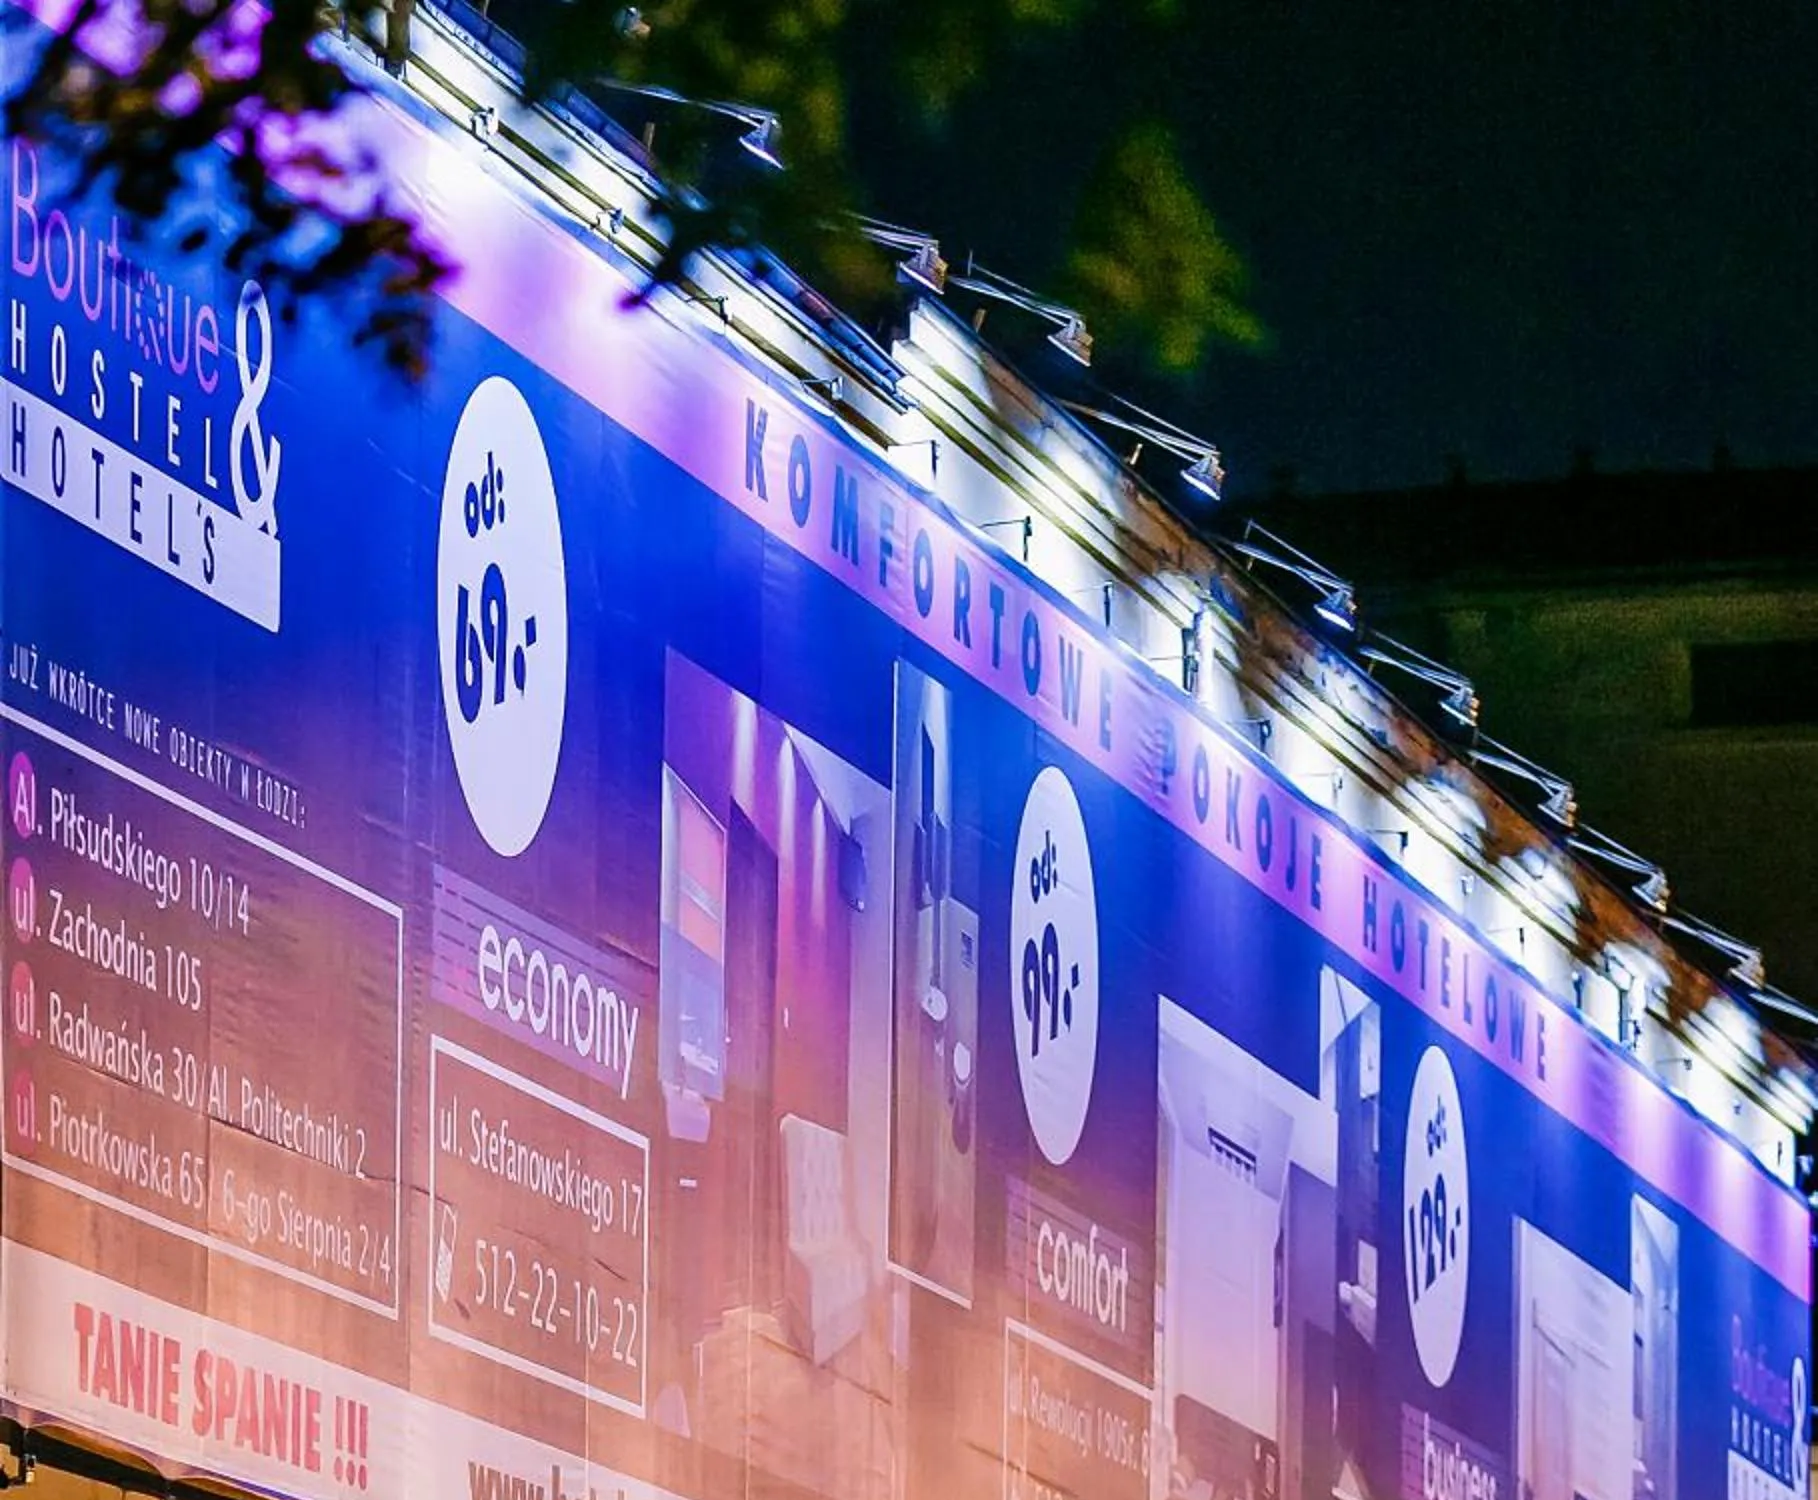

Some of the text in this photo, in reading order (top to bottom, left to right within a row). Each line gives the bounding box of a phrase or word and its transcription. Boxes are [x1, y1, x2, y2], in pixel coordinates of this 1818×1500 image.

[10, 299, 218, 489] HOSTEL
[463, 451, 505, 539] od:
[48, 660, 115, 730] WKRÓTCE
[124, 702, 161, 755] NOWE
[169, 727, 232, 792] OBIEKTY
[745, 397, 1112, 753] KOMFORTOWE
[1363, 873, 1546, 1083] HOTELOWE
[13, 771, 250, 935] Al. Piłsudskiego 10/14
[1030, 829, 1057, 905] od:
[14, 877, 201, 1011] ul. Zachodnia 105
[479, 924, 639, 1100] economy
[14, 979, 41, 1040] ul.
[48, 991, 165, 1096] Radwańska
[241, 1076, 351, 1176] Politechniki
[355, 1128, 367, 1180] 2
[16, 1082, 42, 1143] ul.
[49, 1095, 173, 1198] Piotrkowska
[223, 1169, 271, 1244] 6-go
[277, 1190, 352, 1270] Sierpnia
[359, 1225, 391, 1285] 2/4
[439, 1095, 642, 1238] ul. Stefanowskiego 17
[475, 1238, 637, 1368] 512-22-10-22
[1037, 1220, 1129, 1334] comfort
[73, 1302, 369, 1491] TANIE SPANIE !!!
